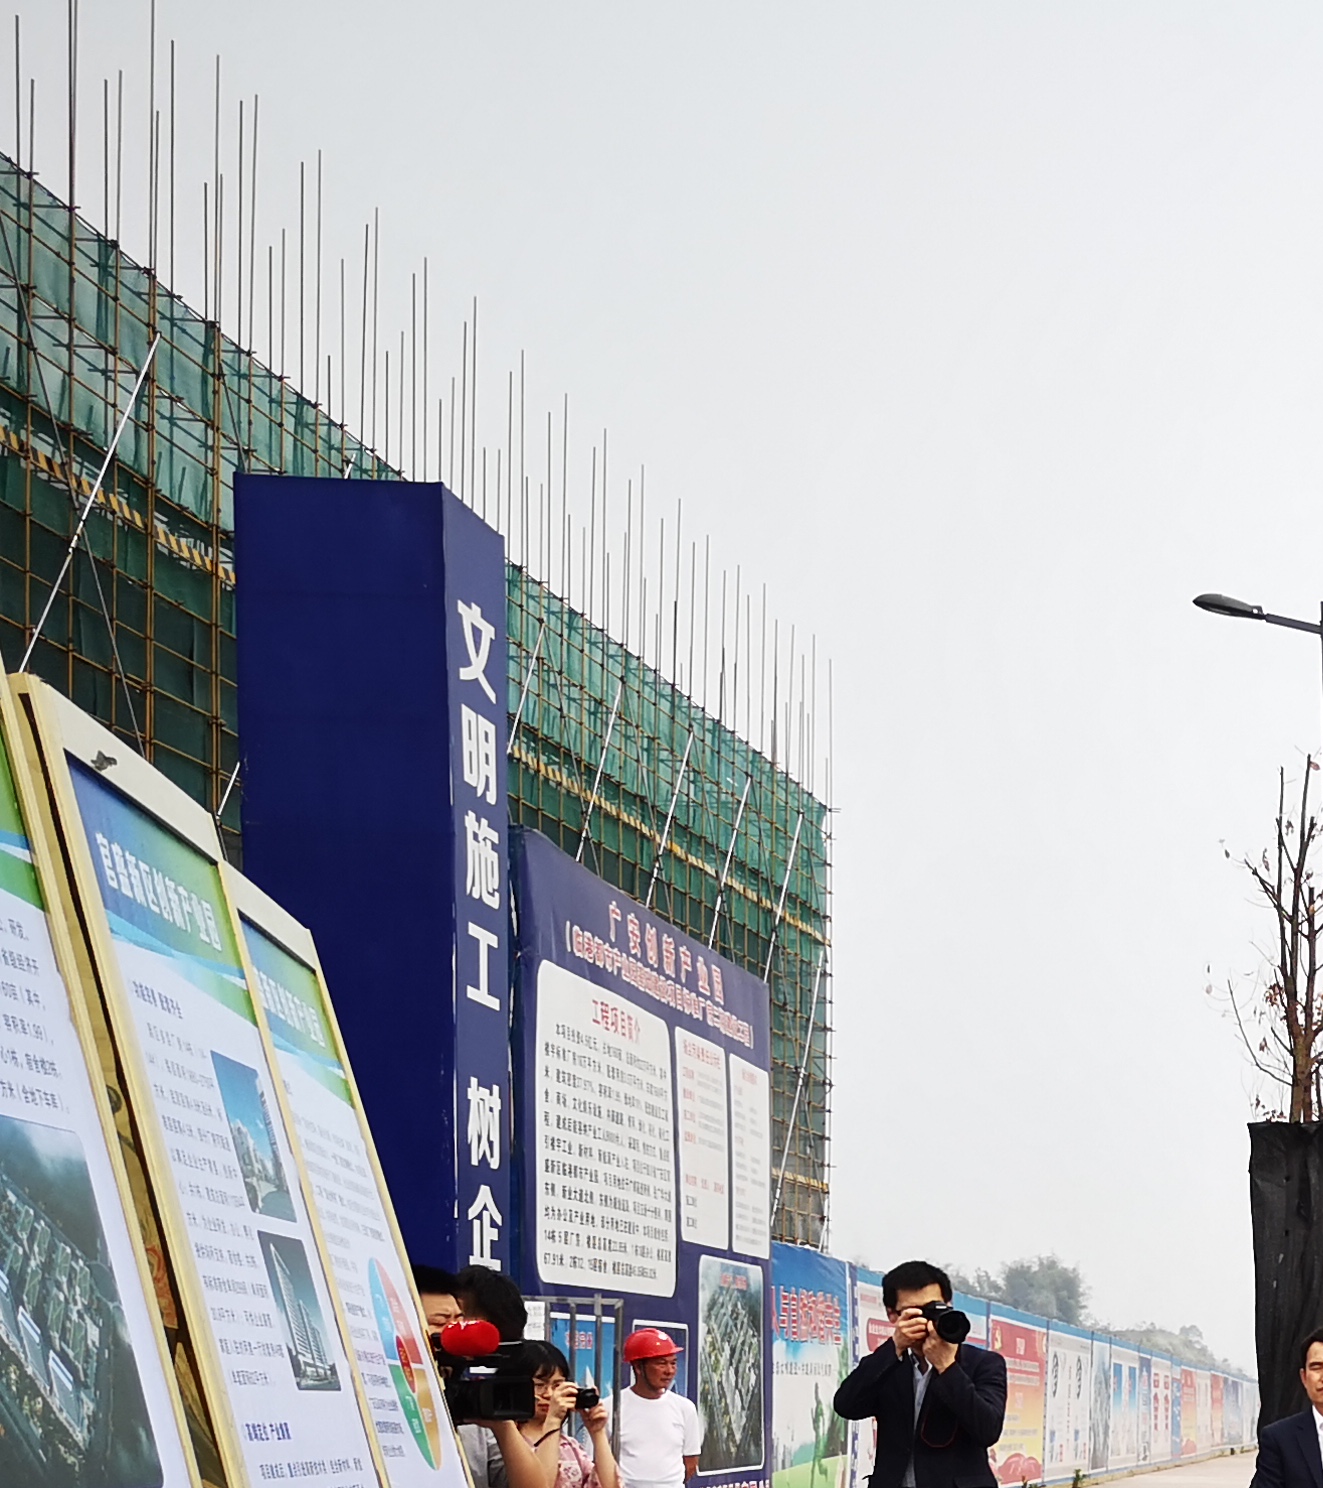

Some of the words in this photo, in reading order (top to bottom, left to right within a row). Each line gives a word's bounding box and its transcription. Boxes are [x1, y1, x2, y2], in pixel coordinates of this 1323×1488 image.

[457, 599, 501, 1012] 文明施工
[592, 999, 641, 1046] 工程项目简介
[608, 900, 725, 1006] 广安创新产业园
[466, 1076, 502, 1272] 树企
